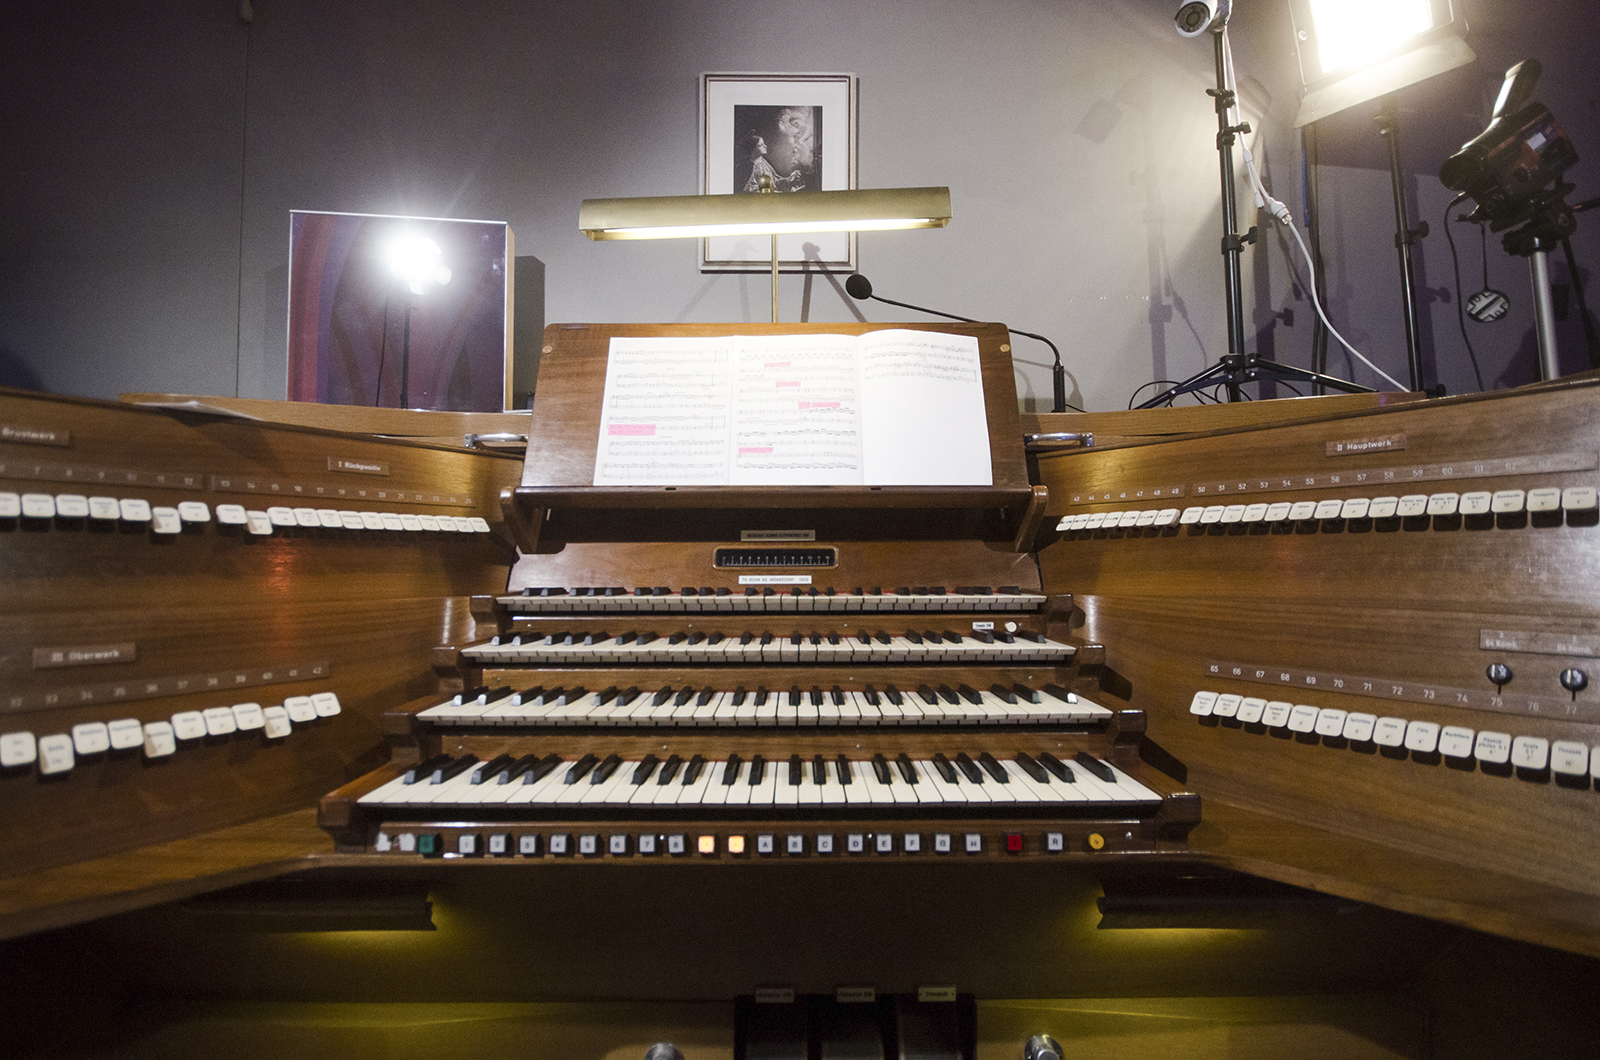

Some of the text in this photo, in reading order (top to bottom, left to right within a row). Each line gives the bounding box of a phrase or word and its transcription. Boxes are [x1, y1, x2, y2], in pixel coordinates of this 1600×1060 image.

[1347, 440, 1392, 451] Hauptwerk
[344, 461, 381, 471] Rückpositiv
[1260, 481, 1268, 489] 53
[1412, 469, 1423, 477] 59
[1442, 467, 1453, 475] 60
[1474, 464, 1484, 473] 61
[1505, 462, 1517, 470] 62
[235, 674, 247, 683] 39
[312, 666, 322, 675] 42
[1210, 665, 1219, 673] 65
[1256, 670, 1265, 678] 67
[1281, 673, 1290, 681] 68
[1306, 676, 1316, 685] 69
[1333, 679, 1344, 688] 70
[1363, 683, 1372, 691] 71
[1392, 686, 1403, 695] 72
[1423, 689, 1435, 699] 73
[1456, 693, 1468, 702] 74
[1491, 697, 1503, 707] 75
[1527, 701, 1539, 711] 76
[882, 840, 887, 848] E
